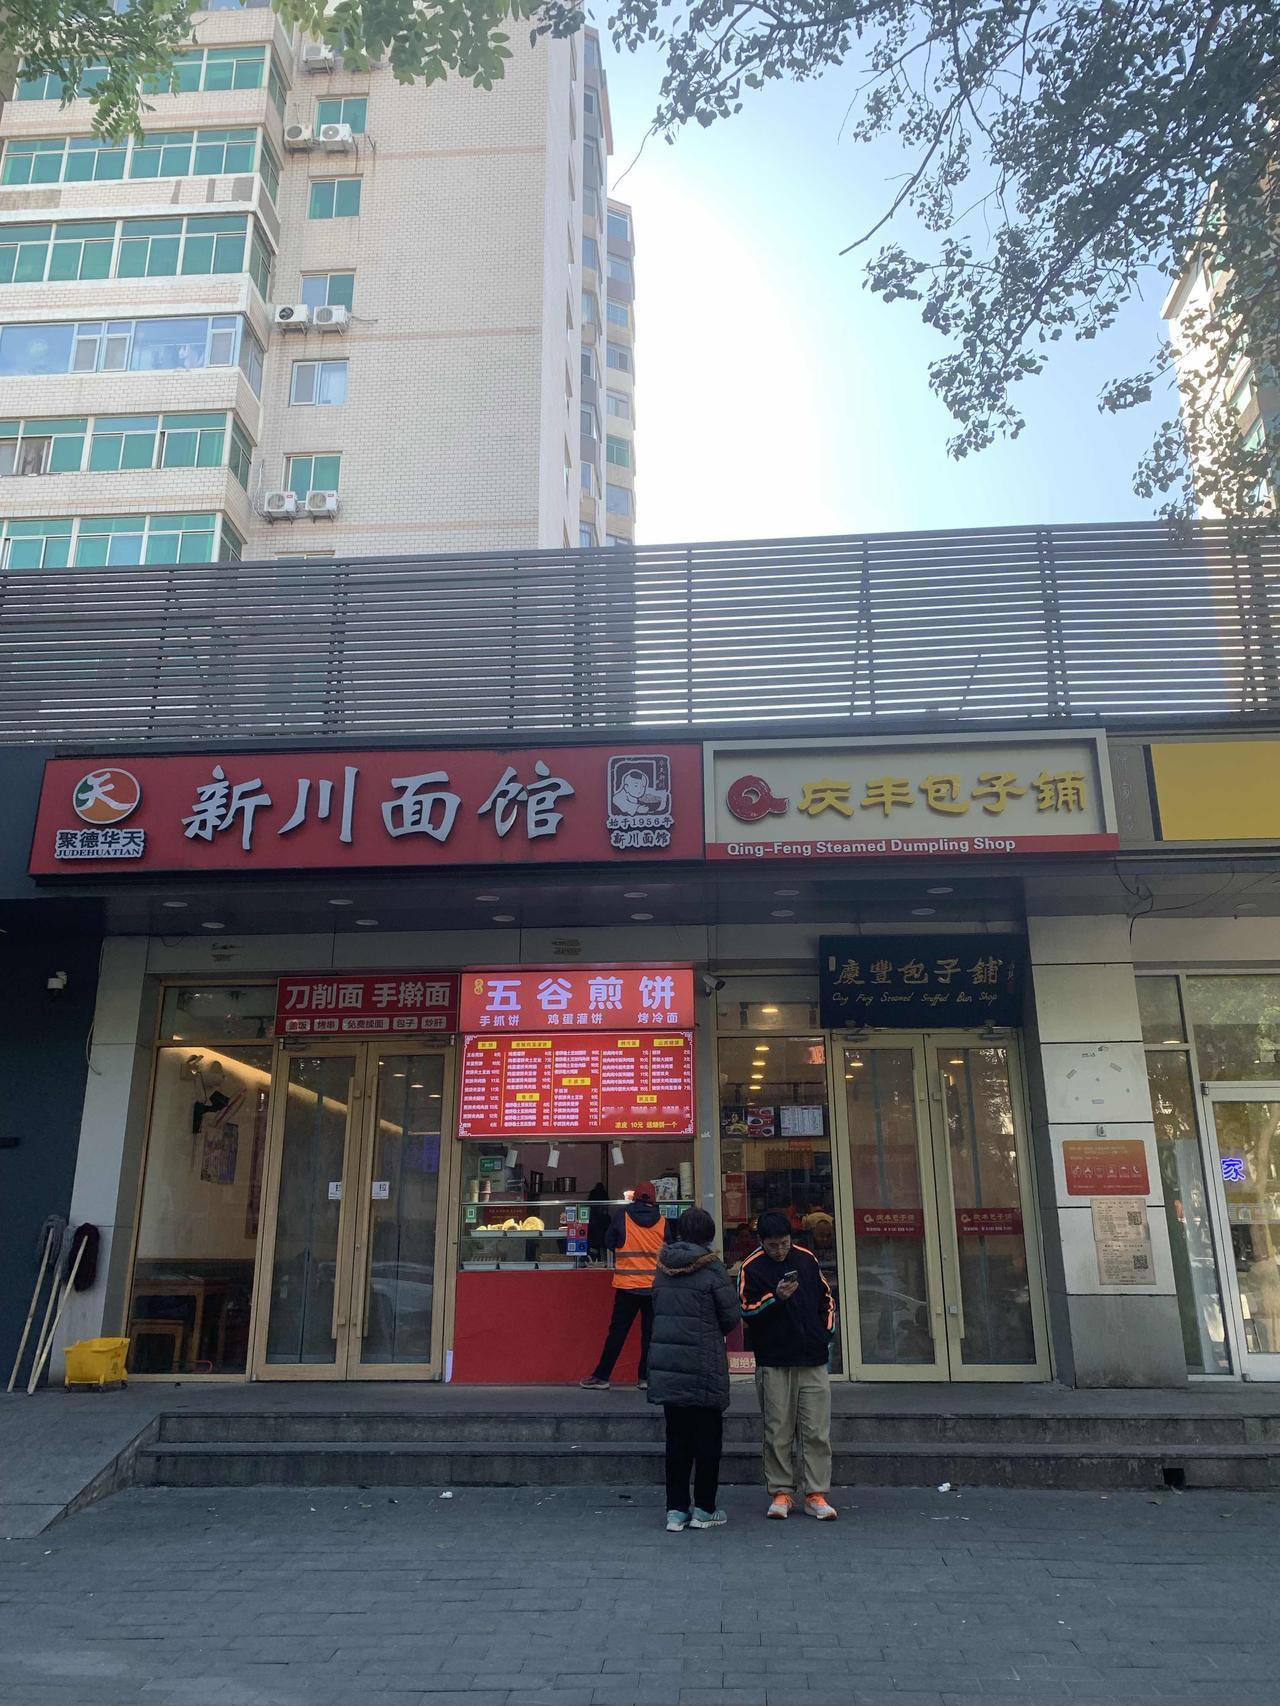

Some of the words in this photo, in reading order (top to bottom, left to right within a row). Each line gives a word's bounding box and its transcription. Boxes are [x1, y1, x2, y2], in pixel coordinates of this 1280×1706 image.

[797, 770, 1086, 817] 庆丰包子铺
[181, 760, 575, 850] 新川面馆
[608, 816, 672, 828] 始于1956年
[58, 830, 142, 848] 聚德华天
[613, 831, 669, 847] 新川面馆
[727, 842, 811, 857] Qing-Feng
[816, 840, 886, 854] Steamed
[891, 838, 969, 853] Dumpling
[973, 837, 1016, 852] Shop
[56, 848, 140, 857] JUDEHUATIAN
[284, 983, 365, 1009] 刀削面
[371, 981, 451, 1008] 手擀面
[485, 976, 676, 1010] 五谷煎饼
[979, 991, 998, 1006] Shop
[396, 1018, 415, 1028] 包子
[479, 1014, 520, 1027] 手抓饼
[547, 1012, 603, 1025] 鸡蛋灌饼
[637, 1012, 678, 1024] 烤冷面
[1221, 1158, 1246, 1182] 家
